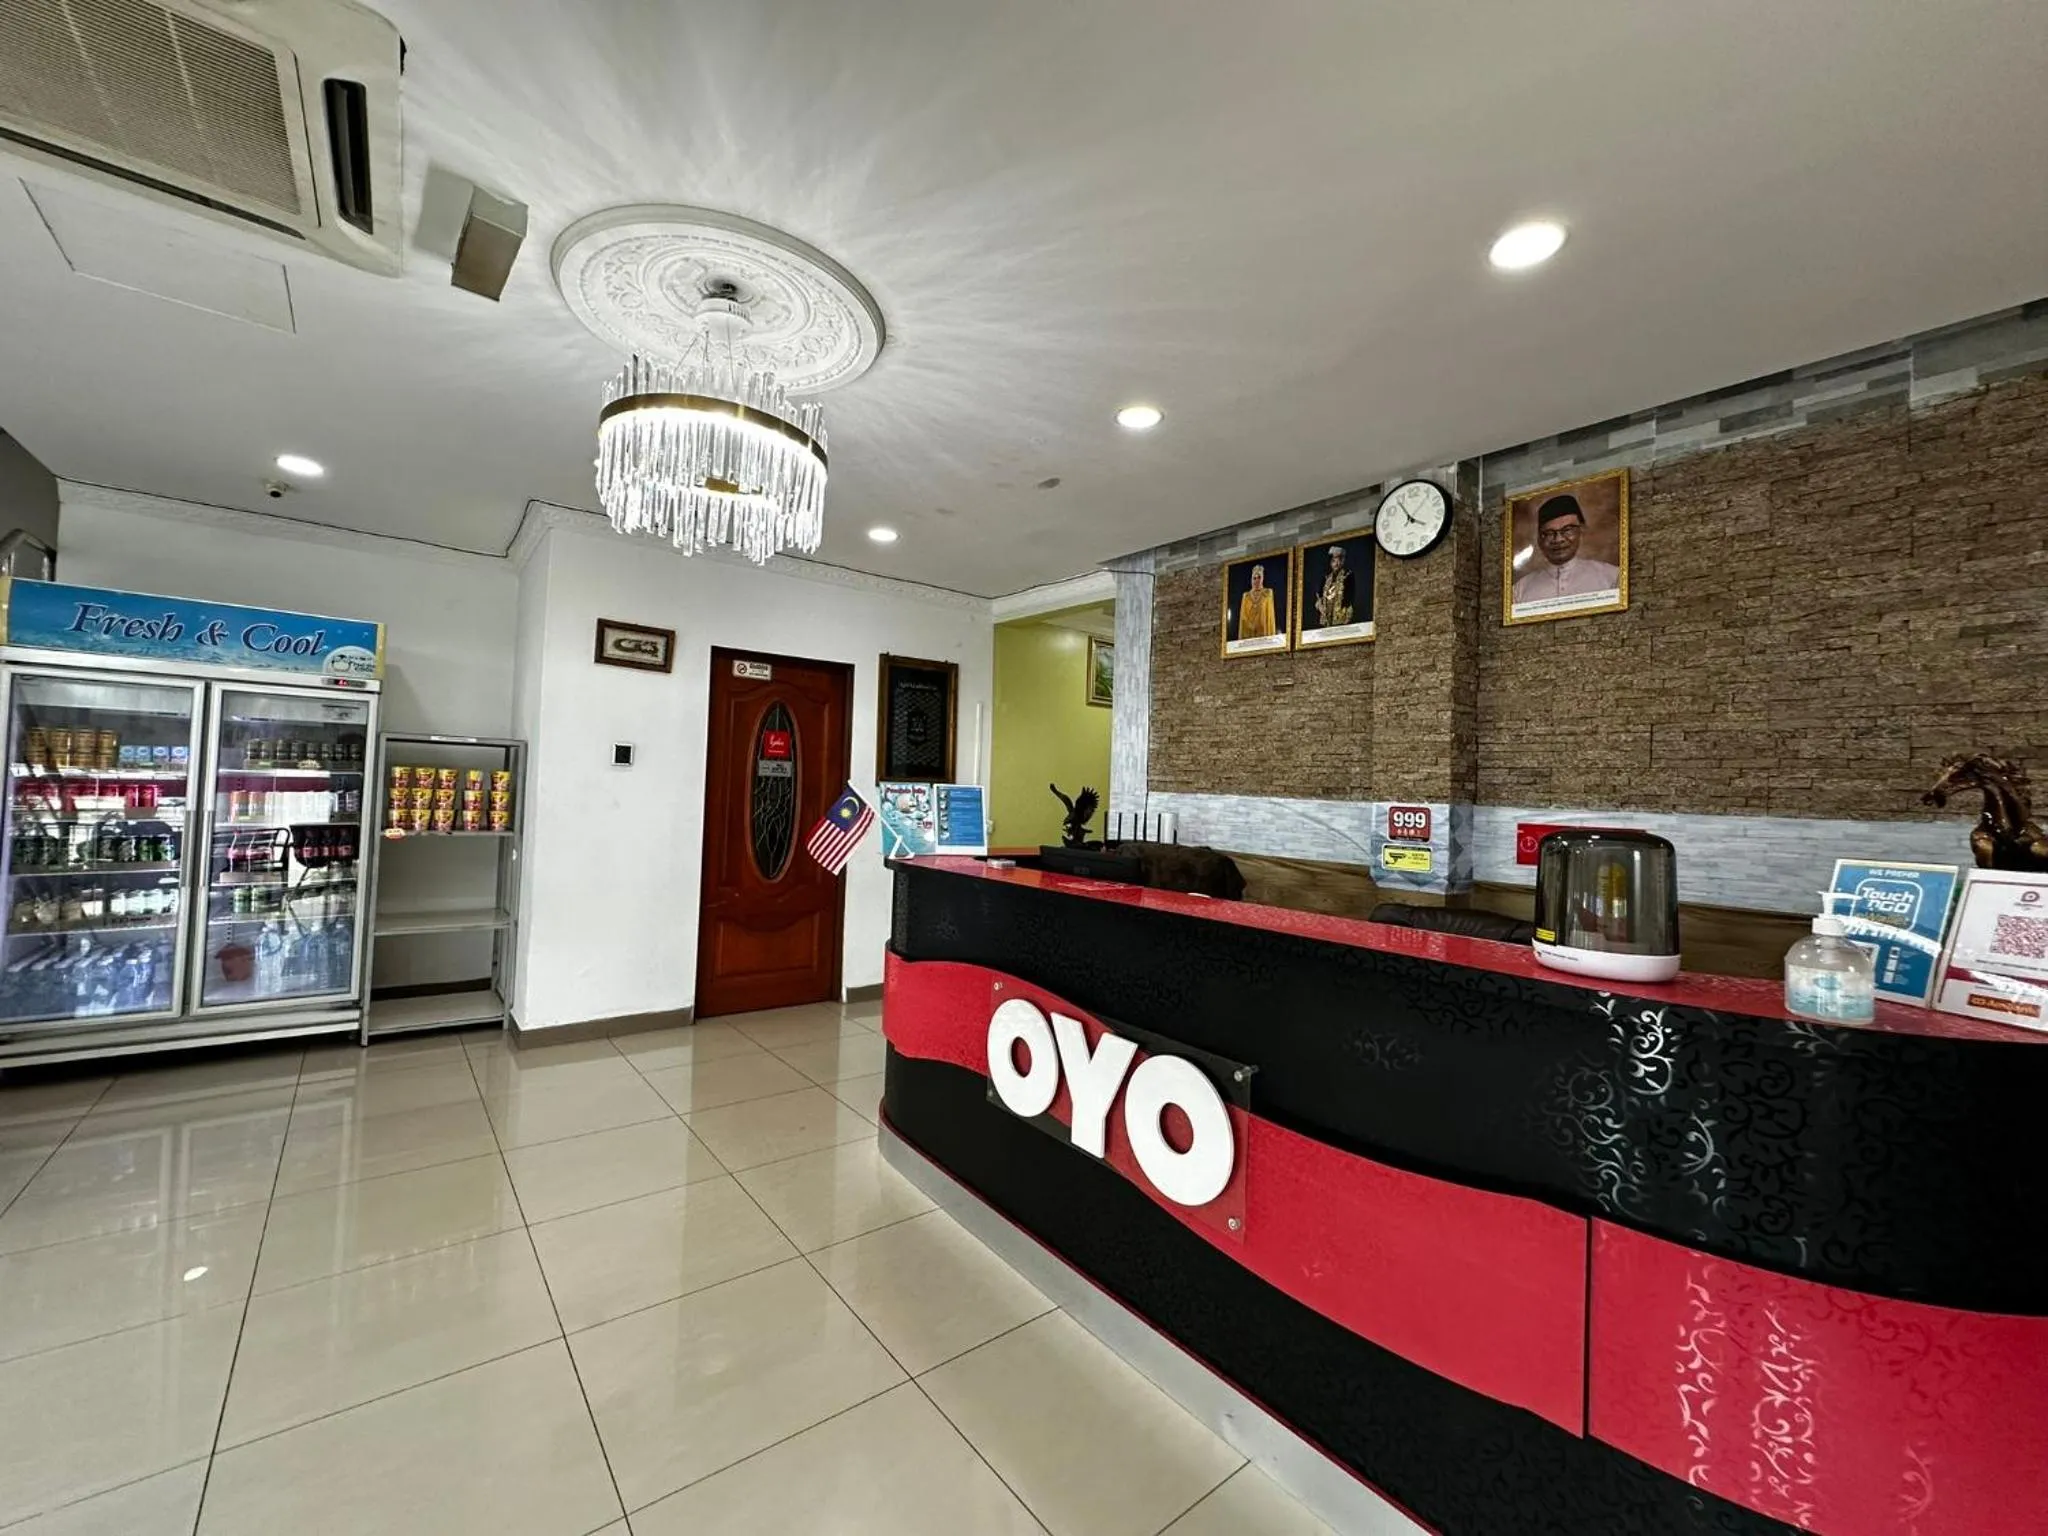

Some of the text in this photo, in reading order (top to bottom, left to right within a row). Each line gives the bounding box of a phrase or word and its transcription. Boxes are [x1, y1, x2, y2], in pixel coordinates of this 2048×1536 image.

[68, 602, 325, 657] Fresh & Cool
[1393, 811, 1426, 828] 999
[1862, 887, 1915, 903] Touch
[986, 998, 1235, 1207] OYO
